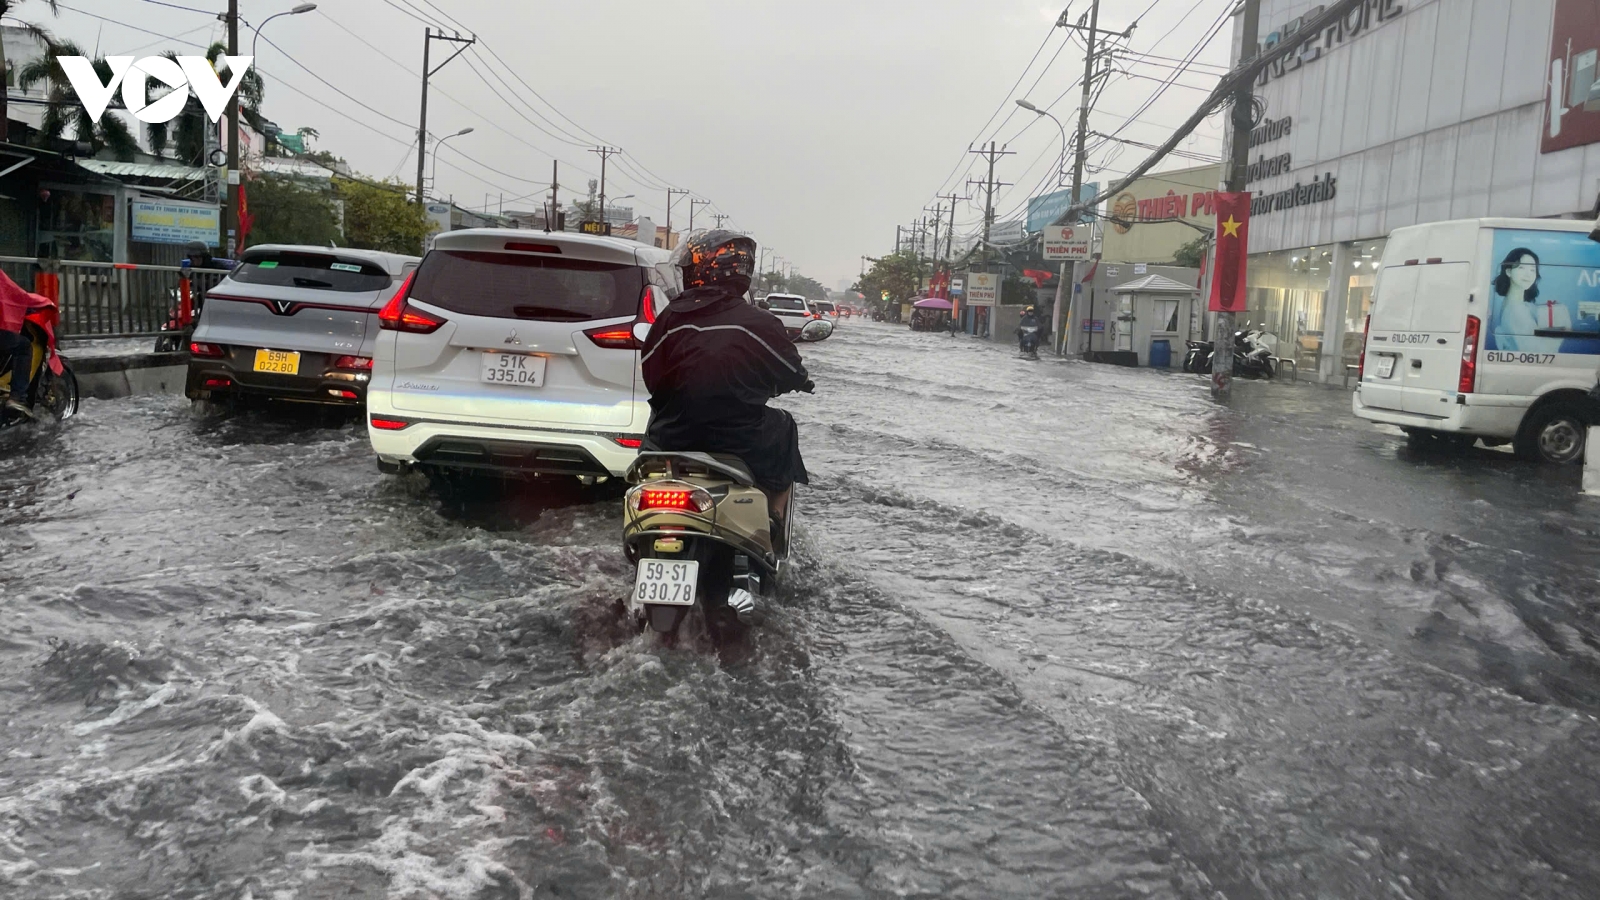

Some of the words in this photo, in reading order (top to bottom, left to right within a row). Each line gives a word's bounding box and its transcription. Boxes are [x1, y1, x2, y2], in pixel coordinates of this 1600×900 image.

[1274, 172, 1336, 211] materials
[1137, 189, 1188, 221] THIÊN
[1191, 190, 1217, 217] PH
[1046, 246, 1069, 254] THIÊN
[1071, 246, 1088, 254] PHÚ
[268, 352, 288, 363] 69H
[499, 356, 526, 370] 51K
[1487, 352, 1555, 364] 61LD-061.77
[259, 361, 294, 373] 022.80
[487, 368, 537, 384] 335.04
[646, 563, 687, 582] 59-S1
[638, 582, 692, 601] 830.78
